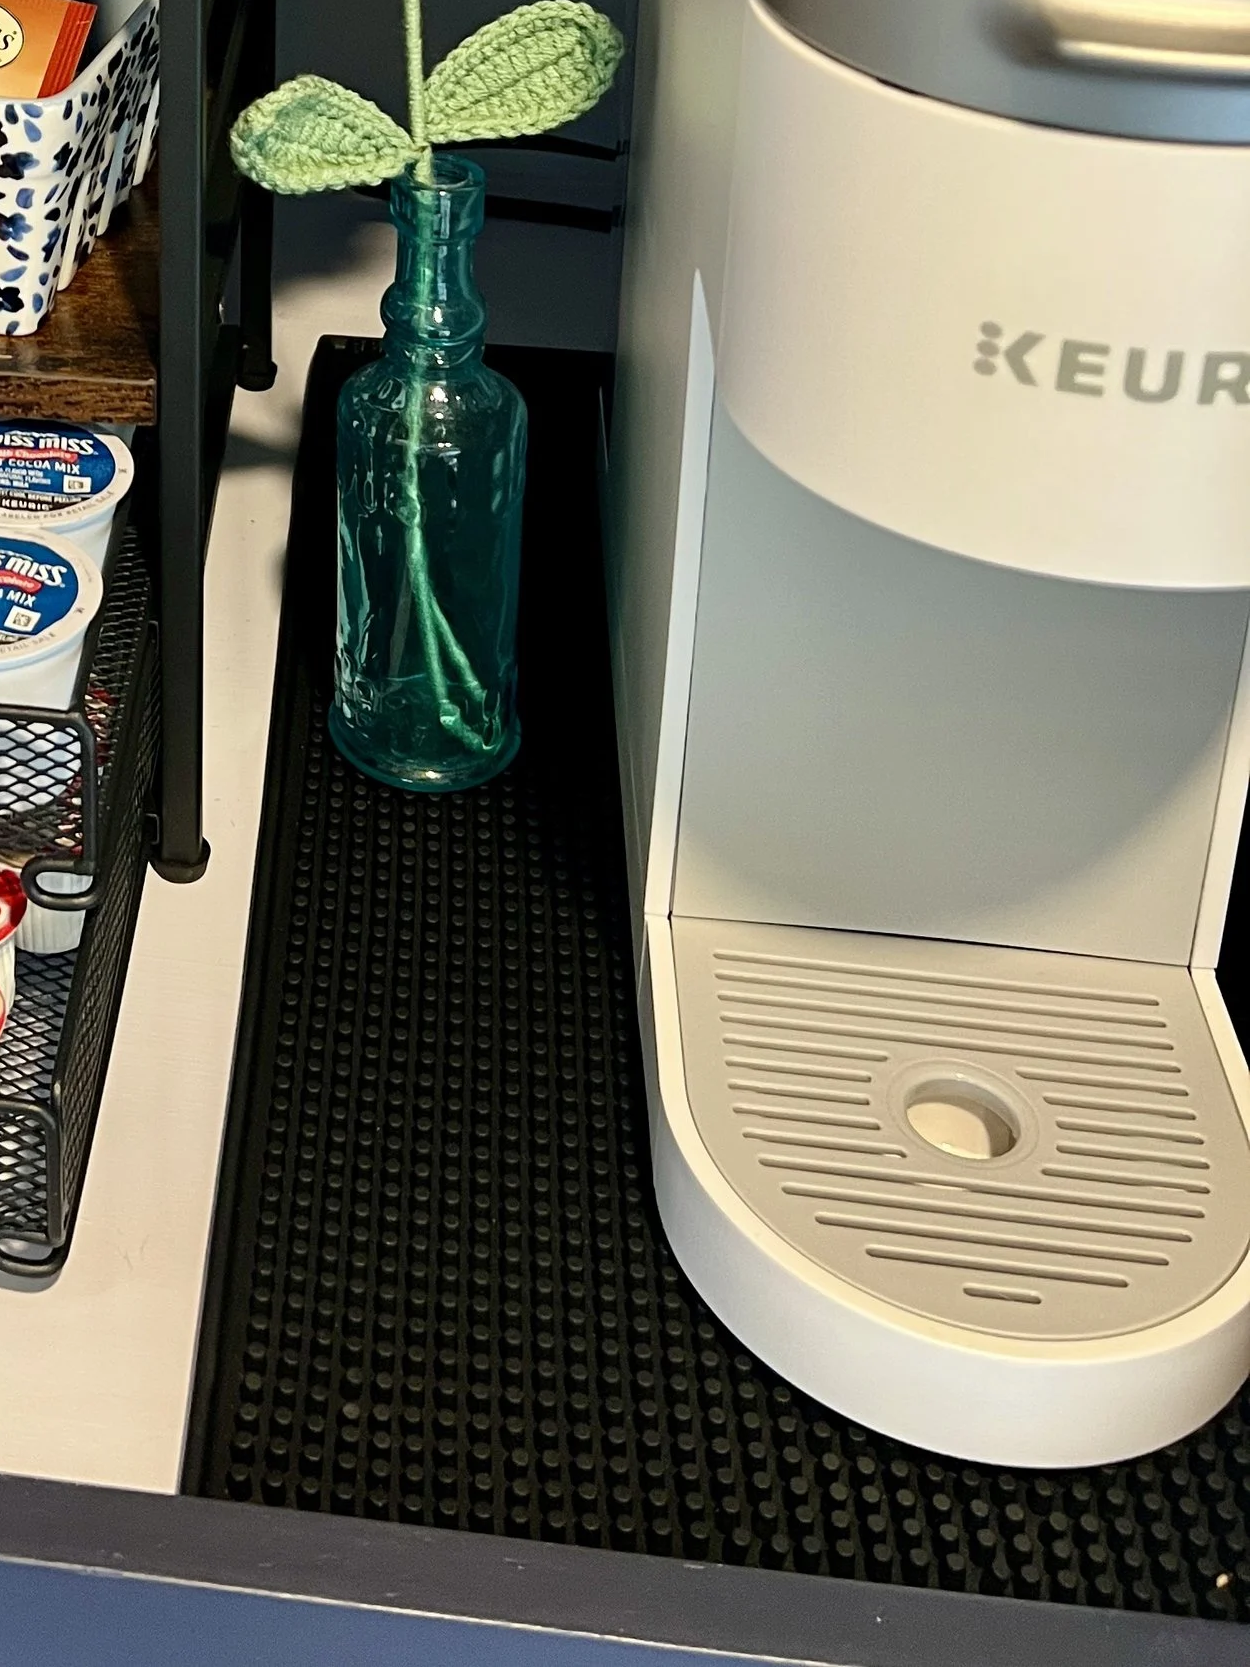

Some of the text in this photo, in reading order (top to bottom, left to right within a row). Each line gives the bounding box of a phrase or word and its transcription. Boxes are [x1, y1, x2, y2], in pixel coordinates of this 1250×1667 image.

[38, 436, 95, 455] MISS
[8, 460, 51, 469] COCOA
[55, 462, 80, 475] MIX
[2, 499, 49, 511] KEURIG
[5, 558, 67, 587] MISS
[6, 592, 38, 608] MIX
